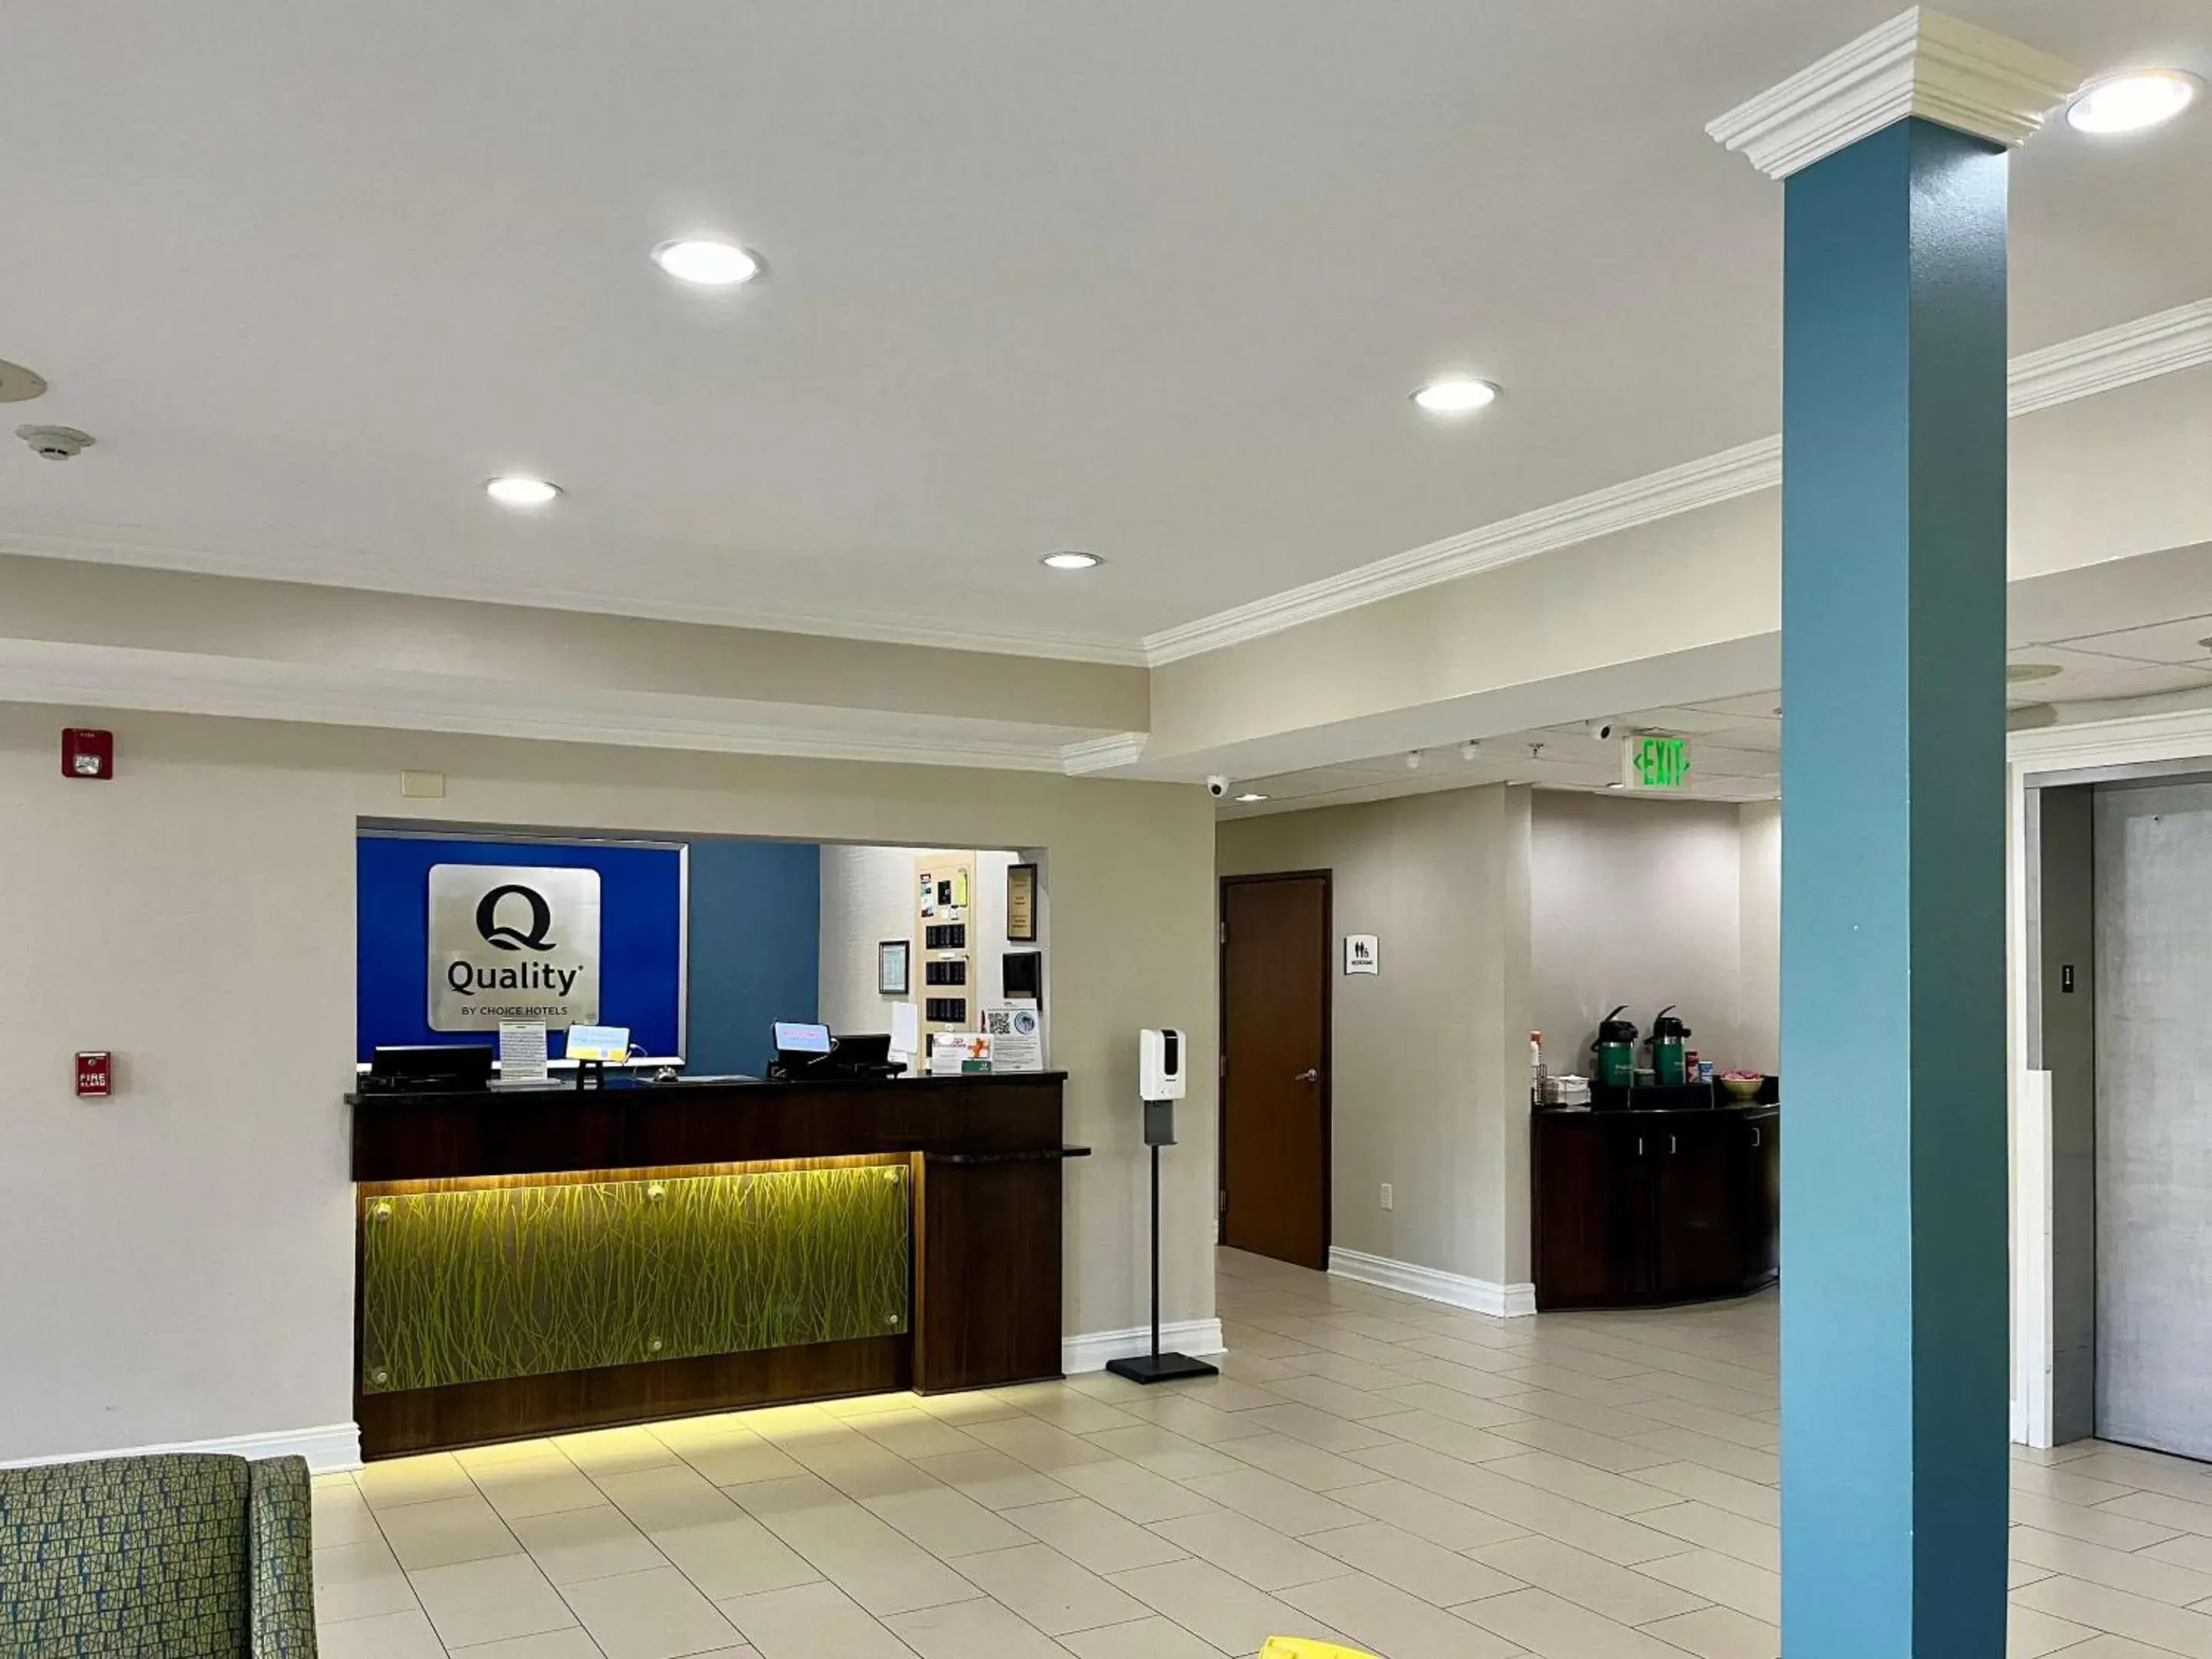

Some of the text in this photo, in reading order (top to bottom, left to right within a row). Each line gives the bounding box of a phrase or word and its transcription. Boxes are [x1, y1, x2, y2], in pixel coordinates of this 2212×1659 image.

[1643, 740, 1684, 786] EXIT
[475, 884, 557, 952] Q
[448, 960, 578, 996] Quality
[462, 1006, 568, 1015] BY CHOICE HOTELS
[79, 1073, 106, 1082] FIRE
